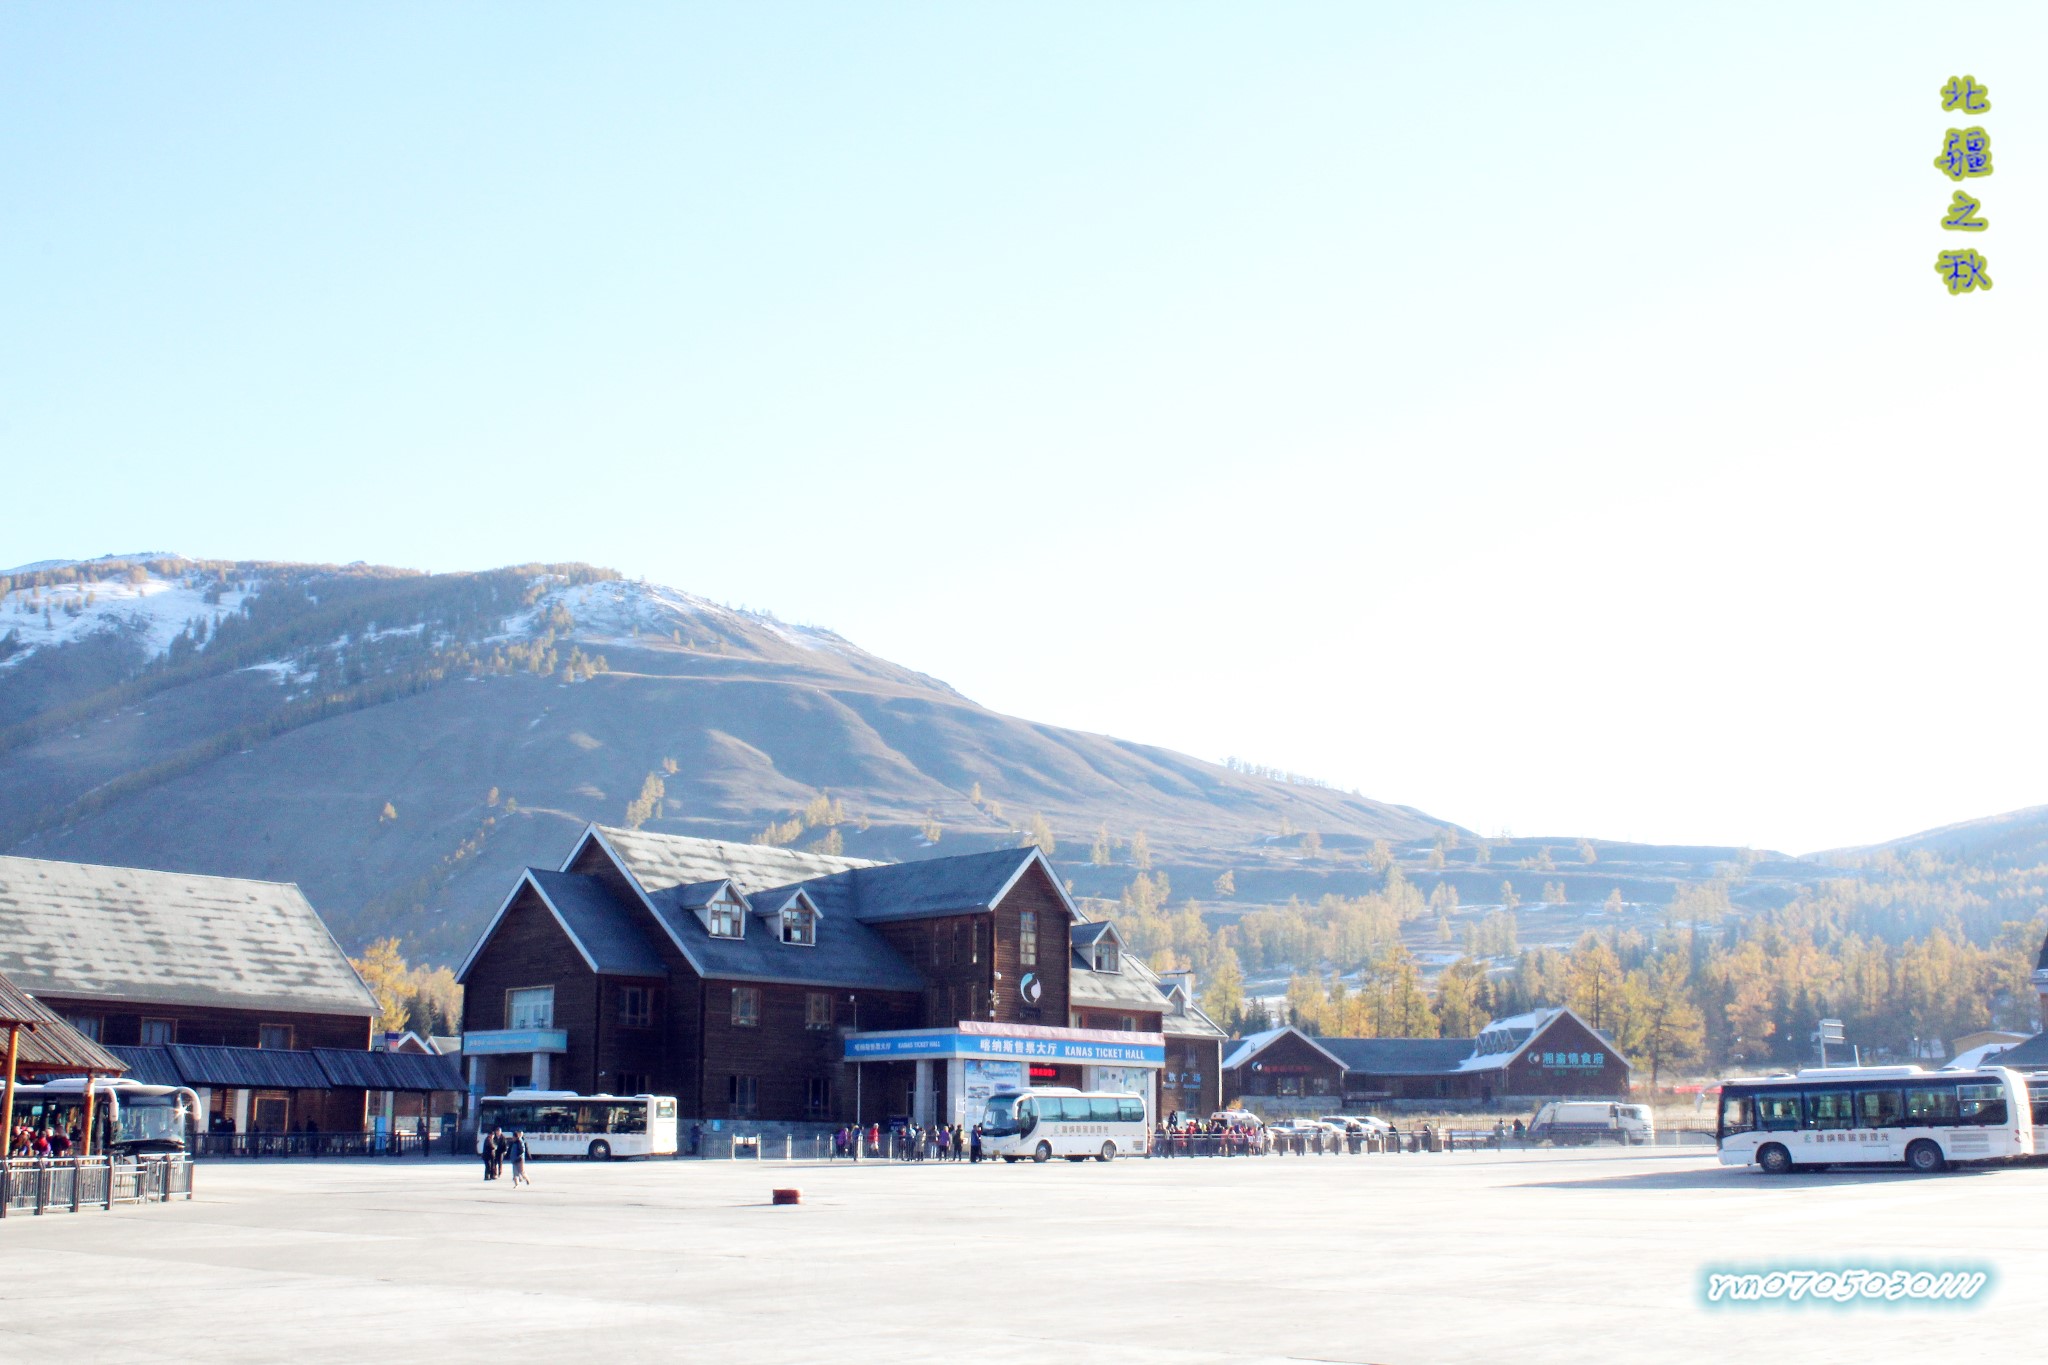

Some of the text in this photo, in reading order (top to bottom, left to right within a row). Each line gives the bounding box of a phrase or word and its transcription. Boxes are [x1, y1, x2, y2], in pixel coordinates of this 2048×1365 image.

[980, 1039, 1057, 1056] 喀纳斯售票大厅
[1065, 1045, 1145, 1060] KANAS TICKET HALL
